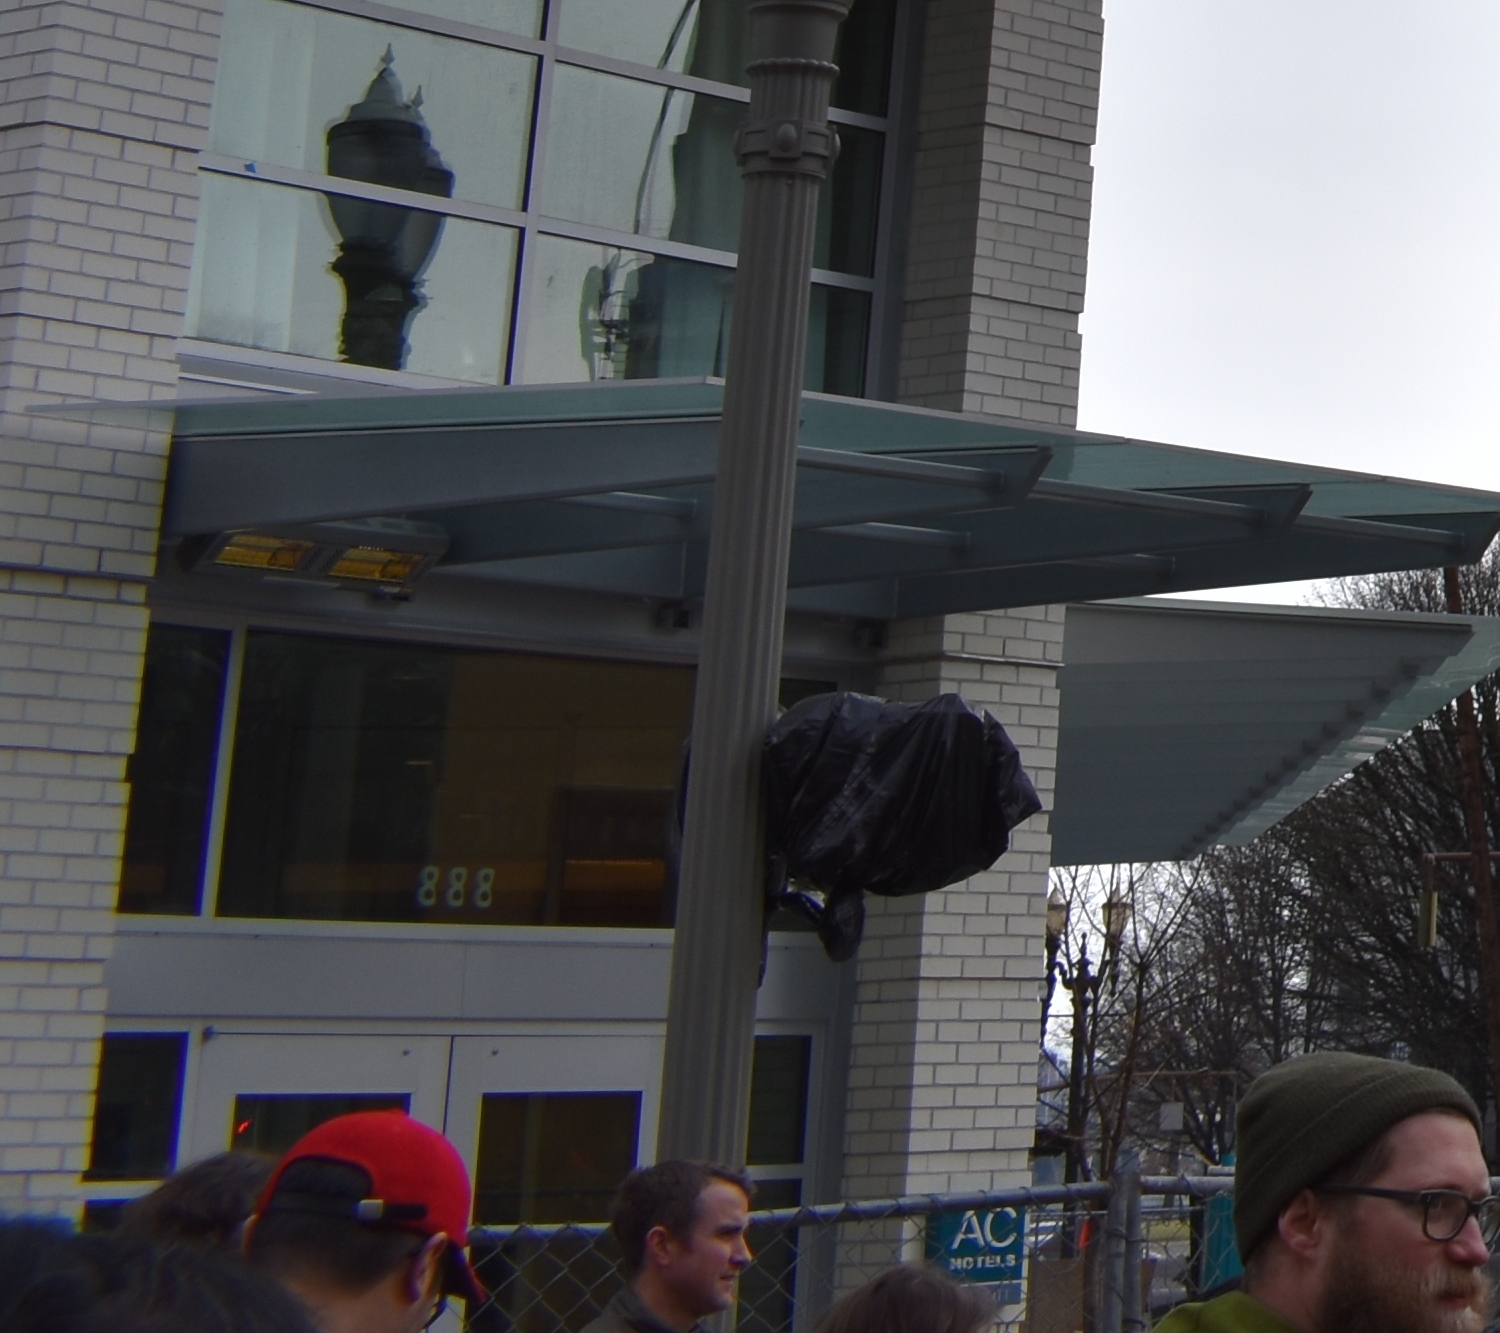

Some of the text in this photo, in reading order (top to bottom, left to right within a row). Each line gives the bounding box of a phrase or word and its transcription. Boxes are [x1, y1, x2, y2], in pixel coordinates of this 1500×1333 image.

[416, 864, 496, 908] 888
[950, 1206, 1018, 1250] AC
[949, 1253, 1016, 1270] HOTELS
